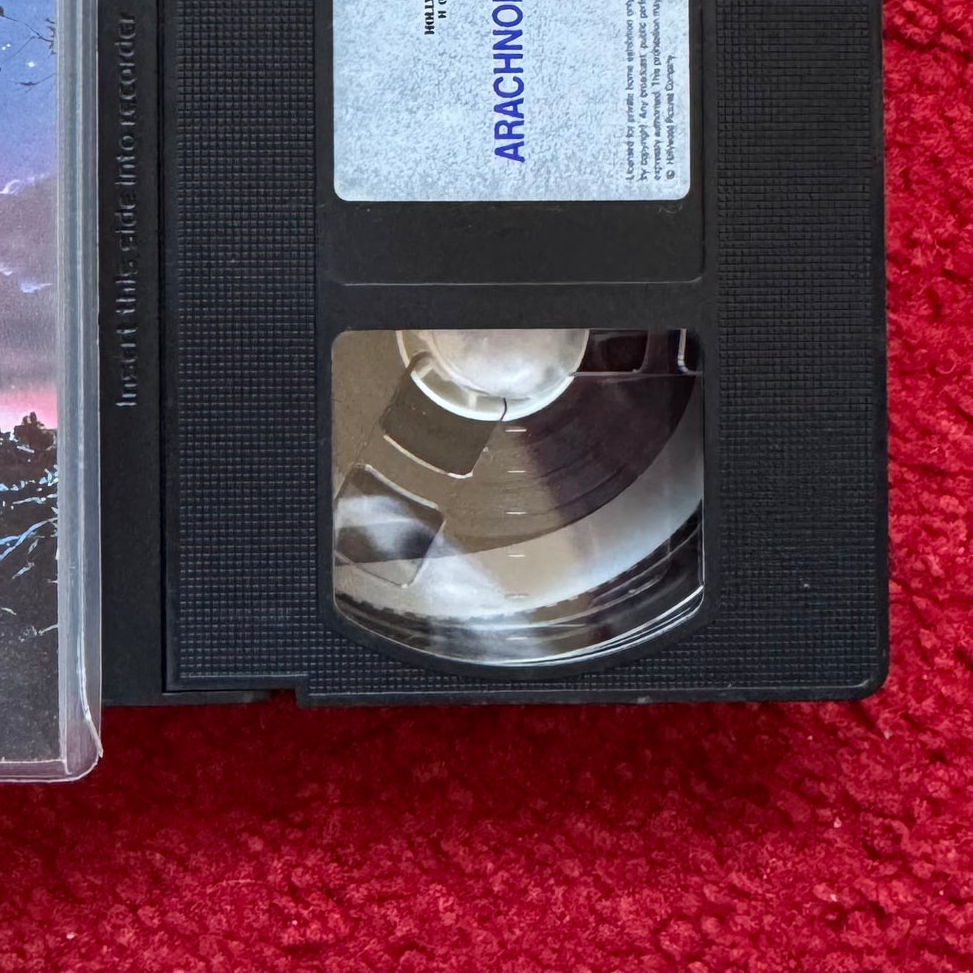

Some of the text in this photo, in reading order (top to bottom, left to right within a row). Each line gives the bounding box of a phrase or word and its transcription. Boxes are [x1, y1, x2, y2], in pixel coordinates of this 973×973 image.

[114, 12, 136, 127] recorder
[638, 100, 648, 119] Any
[114, 135, 136, 186] into
